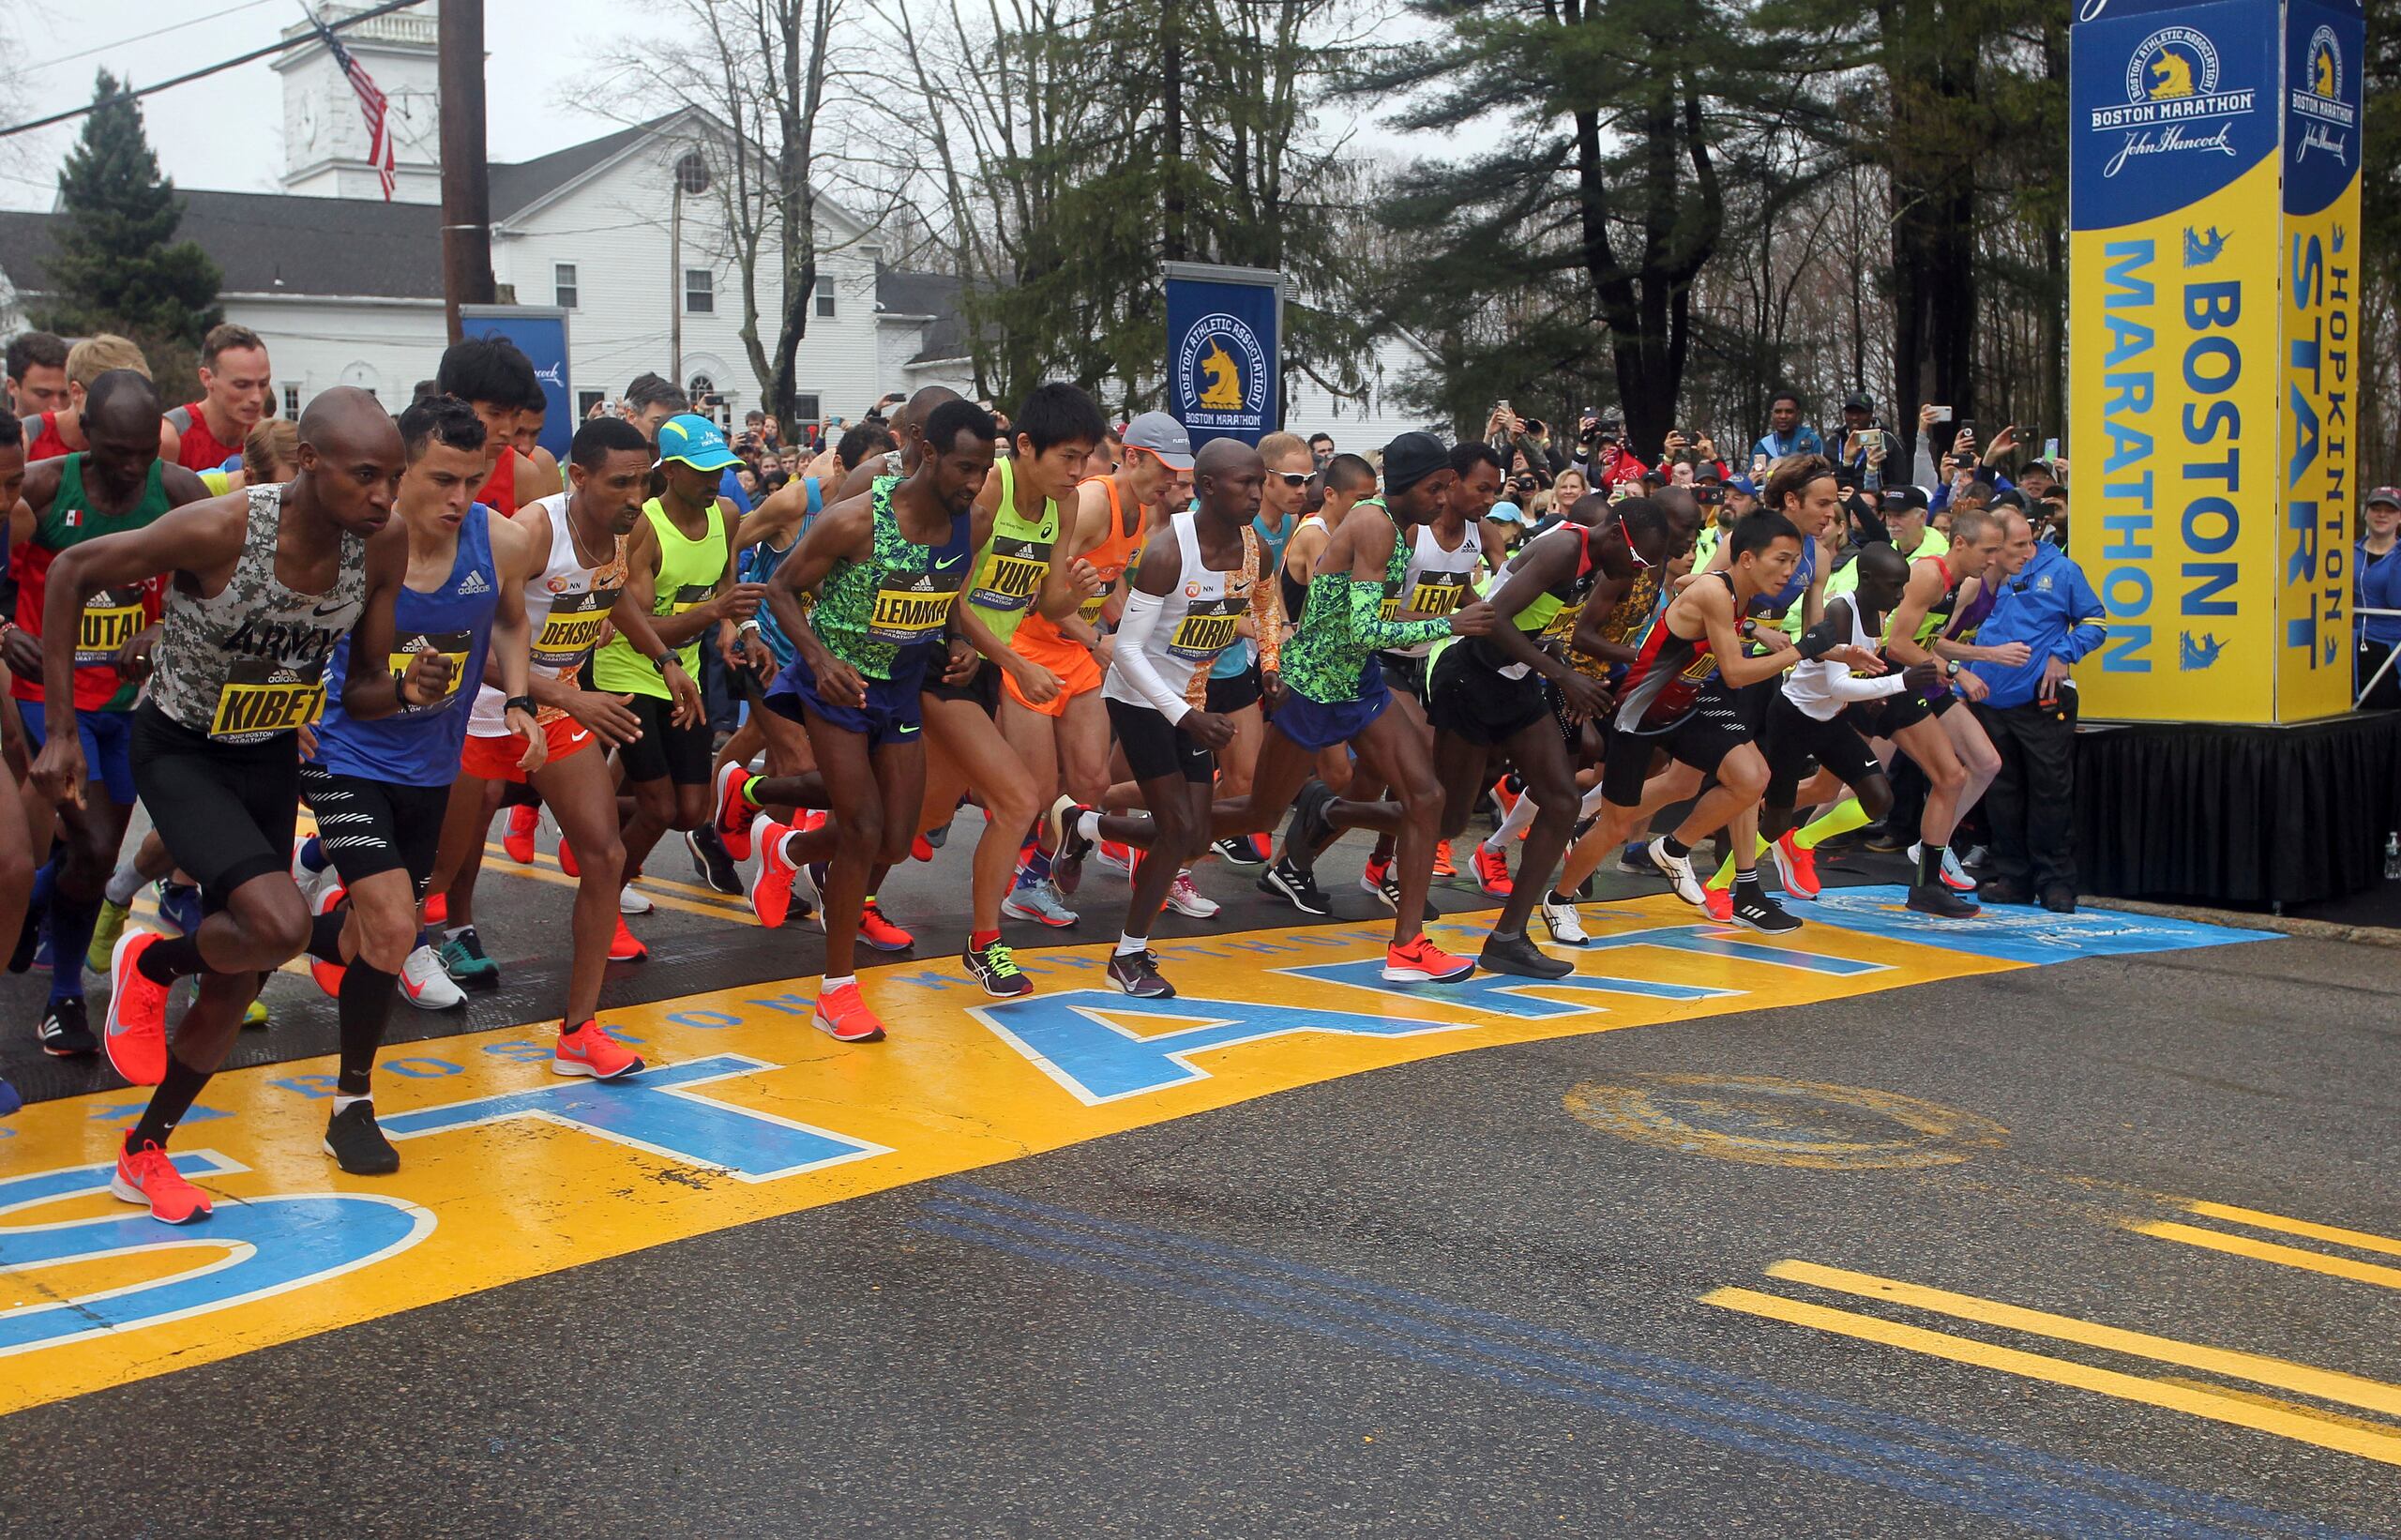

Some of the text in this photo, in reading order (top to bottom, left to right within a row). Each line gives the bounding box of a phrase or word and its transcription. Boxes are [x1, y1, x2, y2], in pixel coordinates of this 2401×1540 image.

[2130, 30, 2215, 98] BOSTON ATHLETIC ASSOCIATION
[2091, 93, 2252, 128] BOSTON MARATHON
[2292, 93, 2354, 124] BOSTON MARATHON
[2104, 122, 2237, 178] John Hancock
[1182, 318, 1264, 403] BOSTON ATHLETIC ASSOCIATION
[1185, 413, 1261, 426] BOSTON MARATHON
[2102, 239, 2155, 673] MARATHON
[2181, 279, 2241, 616] BOSTON
[2288, 233, 2323, 670] START
[2324, 266, 2348, 622] HOPKINTON
[458, 584, 490, 596] adidas
[989, 560, 1043, 595] YUKI
[875, 597, 951, 626] LEMMA
[221, 621, 344, 662] ARMY
[219, 687, 325, 732] KIBET
